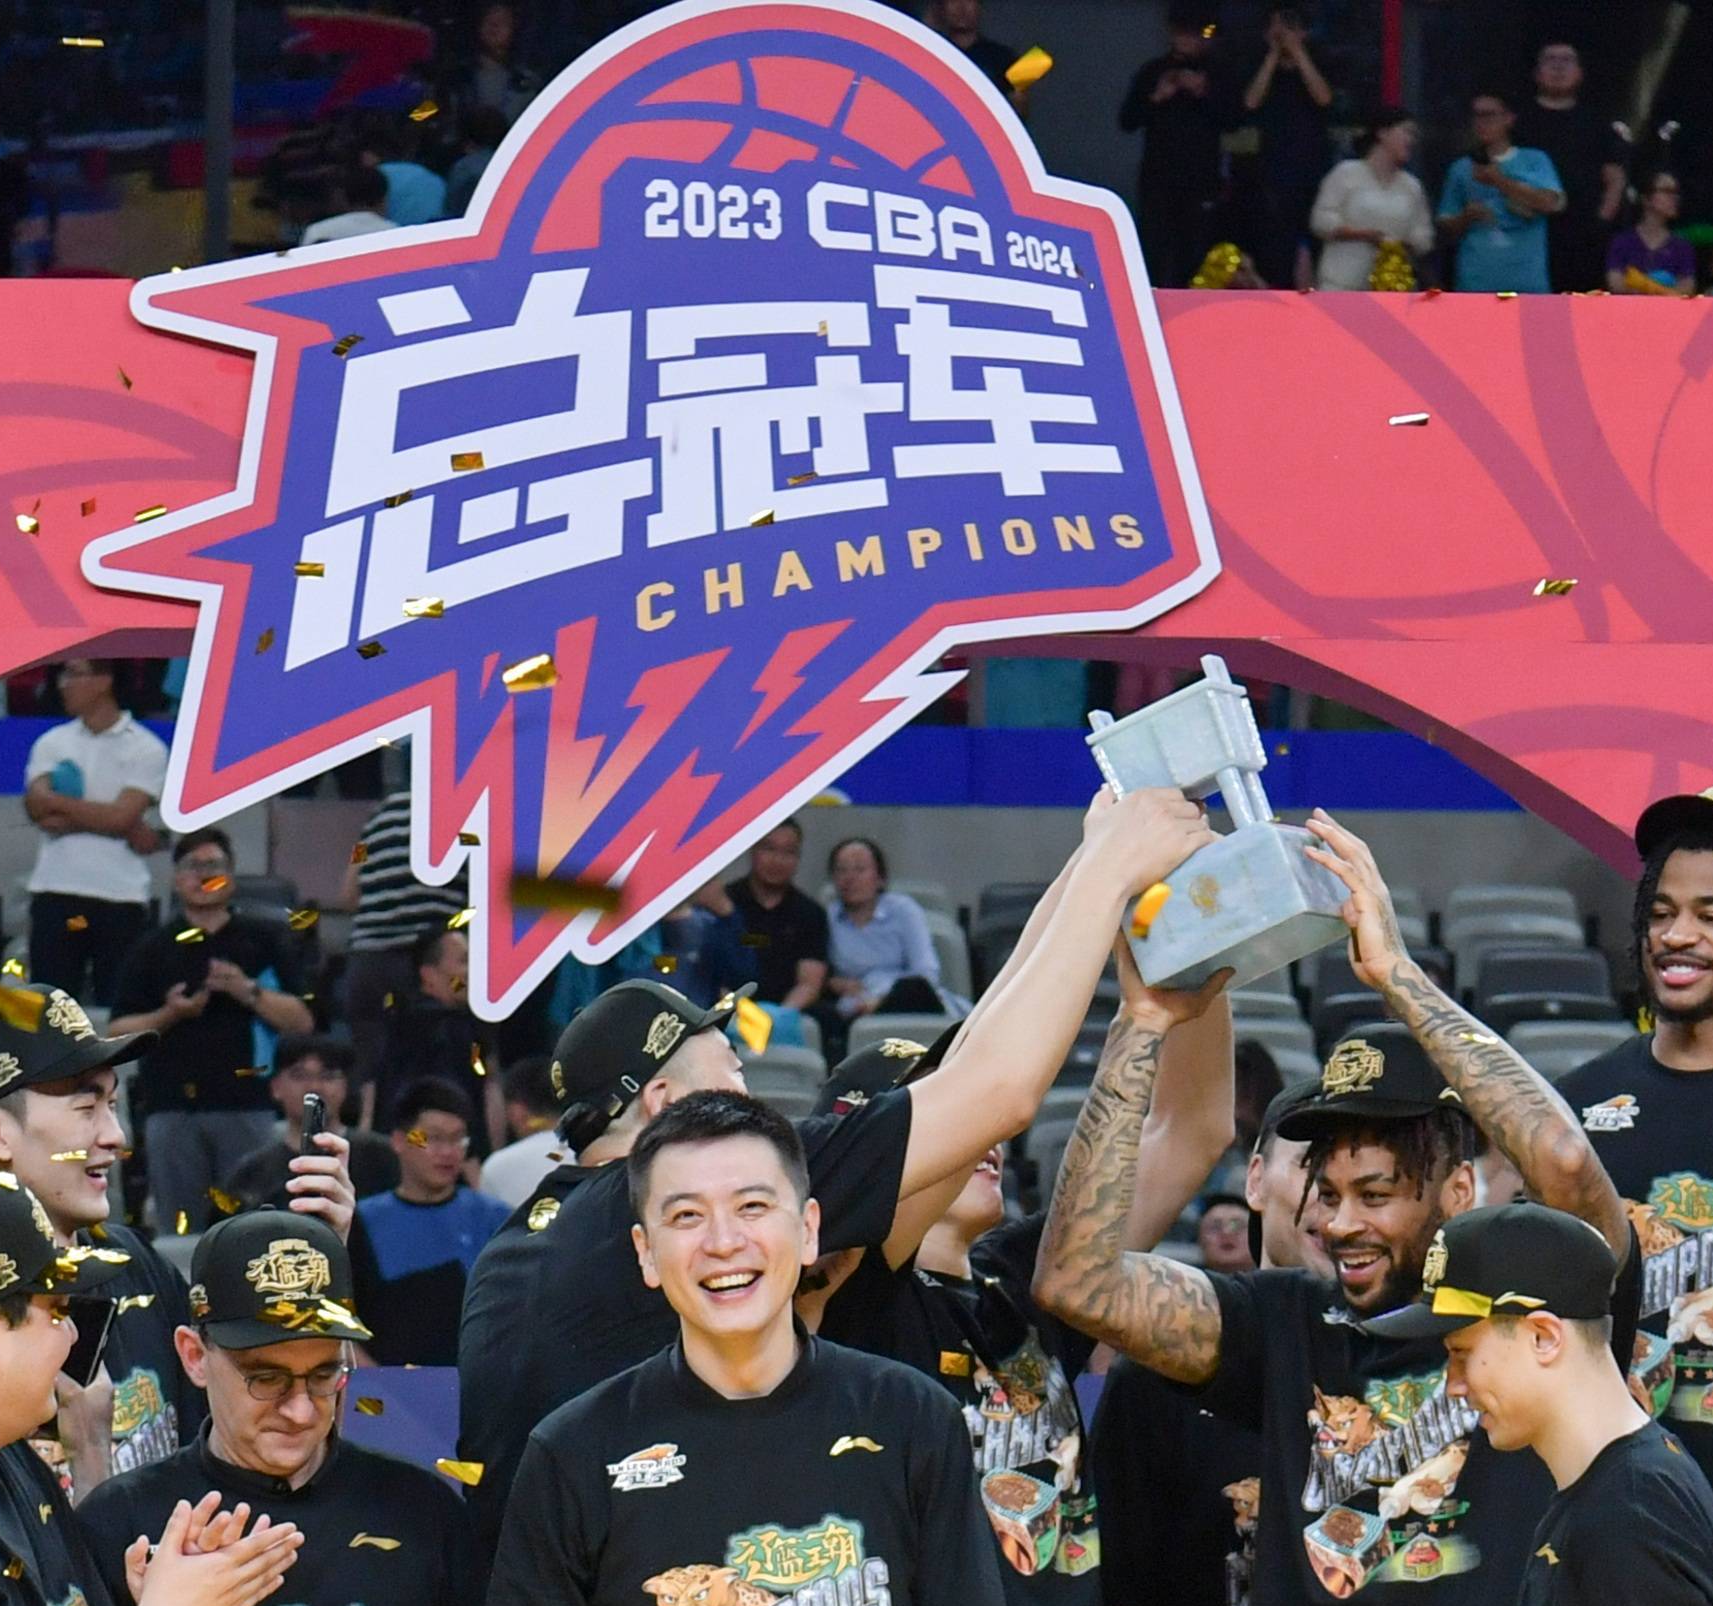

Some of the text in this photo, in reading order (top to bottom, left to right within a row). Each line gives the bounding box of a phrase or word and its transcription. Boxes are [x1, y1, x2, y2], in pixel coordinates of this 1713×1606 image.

[645, 178, 1078, 279] 2023 CBA 2024
[284, 264, 1124, 673] 总冠军
[635, 513, 1146, 633] CHAMPIONS
